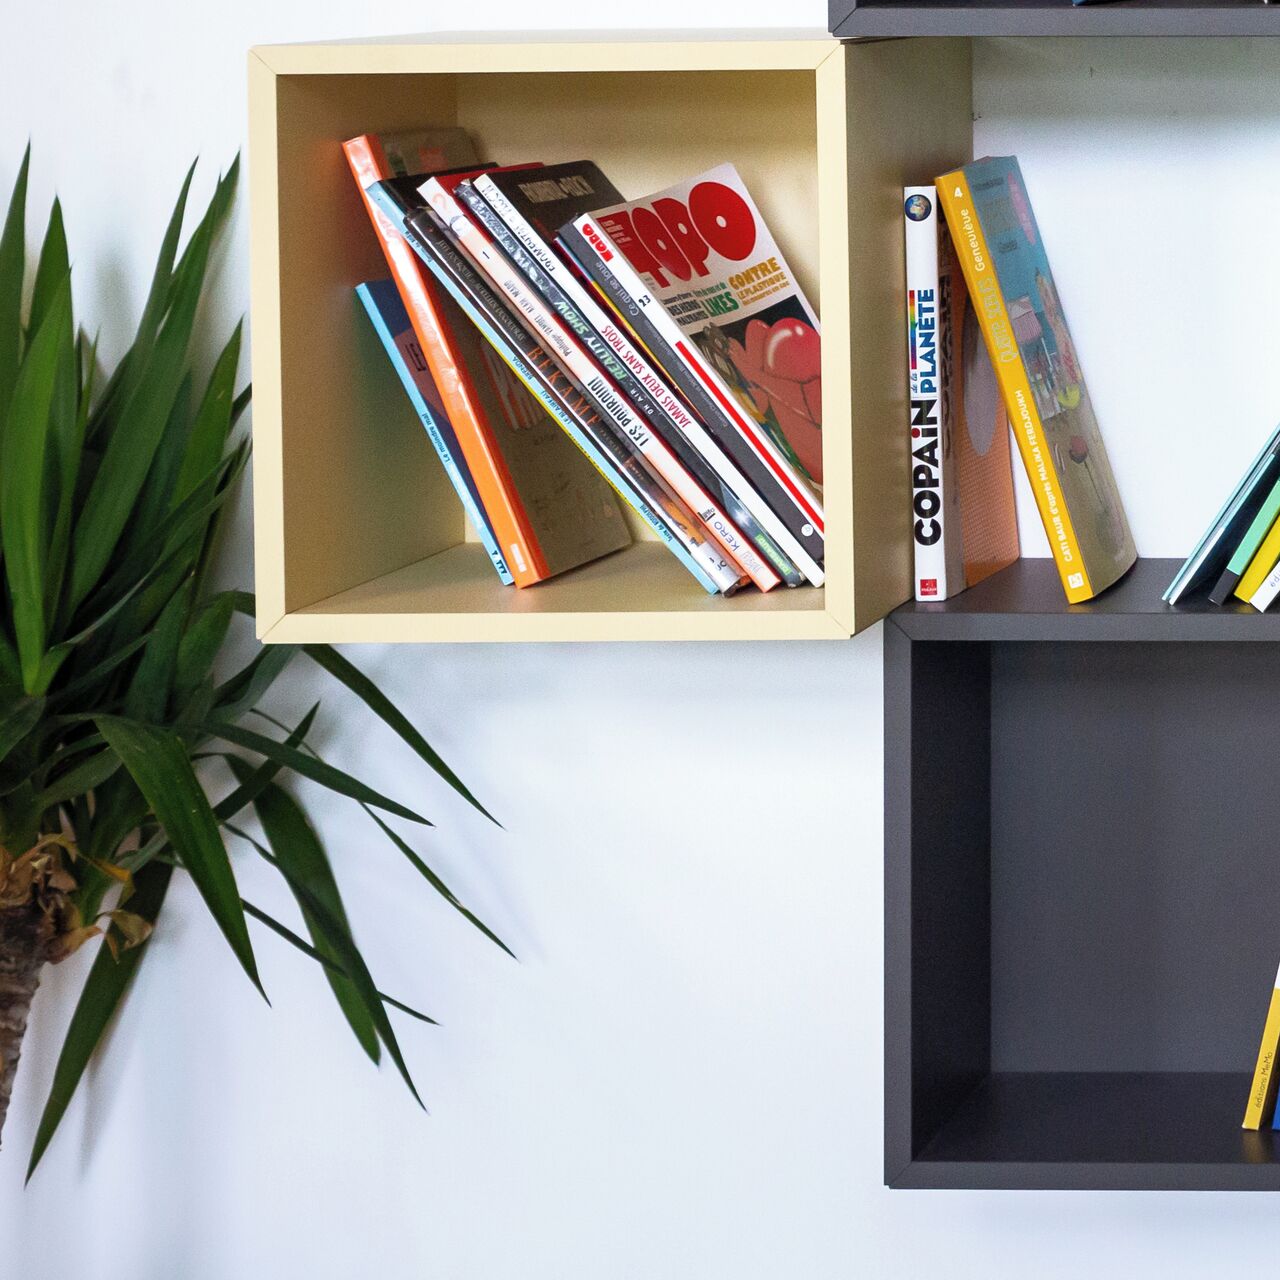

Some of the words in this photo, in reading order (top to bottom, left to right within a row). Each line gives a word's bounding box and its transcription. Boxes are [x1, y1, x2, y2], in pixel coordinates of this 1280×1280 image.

[954, 187, 963, 198] 4
[596, 181, 756, 288] TOPO
[961, 208, 985, 272] Geneviève
[593, 259, 613, 280] joue
[728, 257, 781, 291] CONTRE
[615, 286, 632, 304] qui
[702, 291, 739, 318] LIKES
[553, 297, 589, 336] SHOW
[625, 301, 640, 317] Ce
[600, 325, 625, 353] TROIS
[584, 333, 627, 381] REALITY
[622, 350, 646, 376] SANS
[641, 374, 664, 399] DEUX
[660, 395, 693, 429] JAMAIS
[1015, 389, 1038, 450] FERDJOUKH
[427, 425, 447, 452] moindre
[442, 453, 450, 462] Le
[1032, 447, 1051, 482] MALIKA
[1045, 479, 1061, 519] d'après
[709, 519, 742, 552] KERO
[1053, 519, 1068, 545] BAUR
[1060, 544, 1073, 562] CATI
[1262, 1051, 1273, 1076] MeMo
